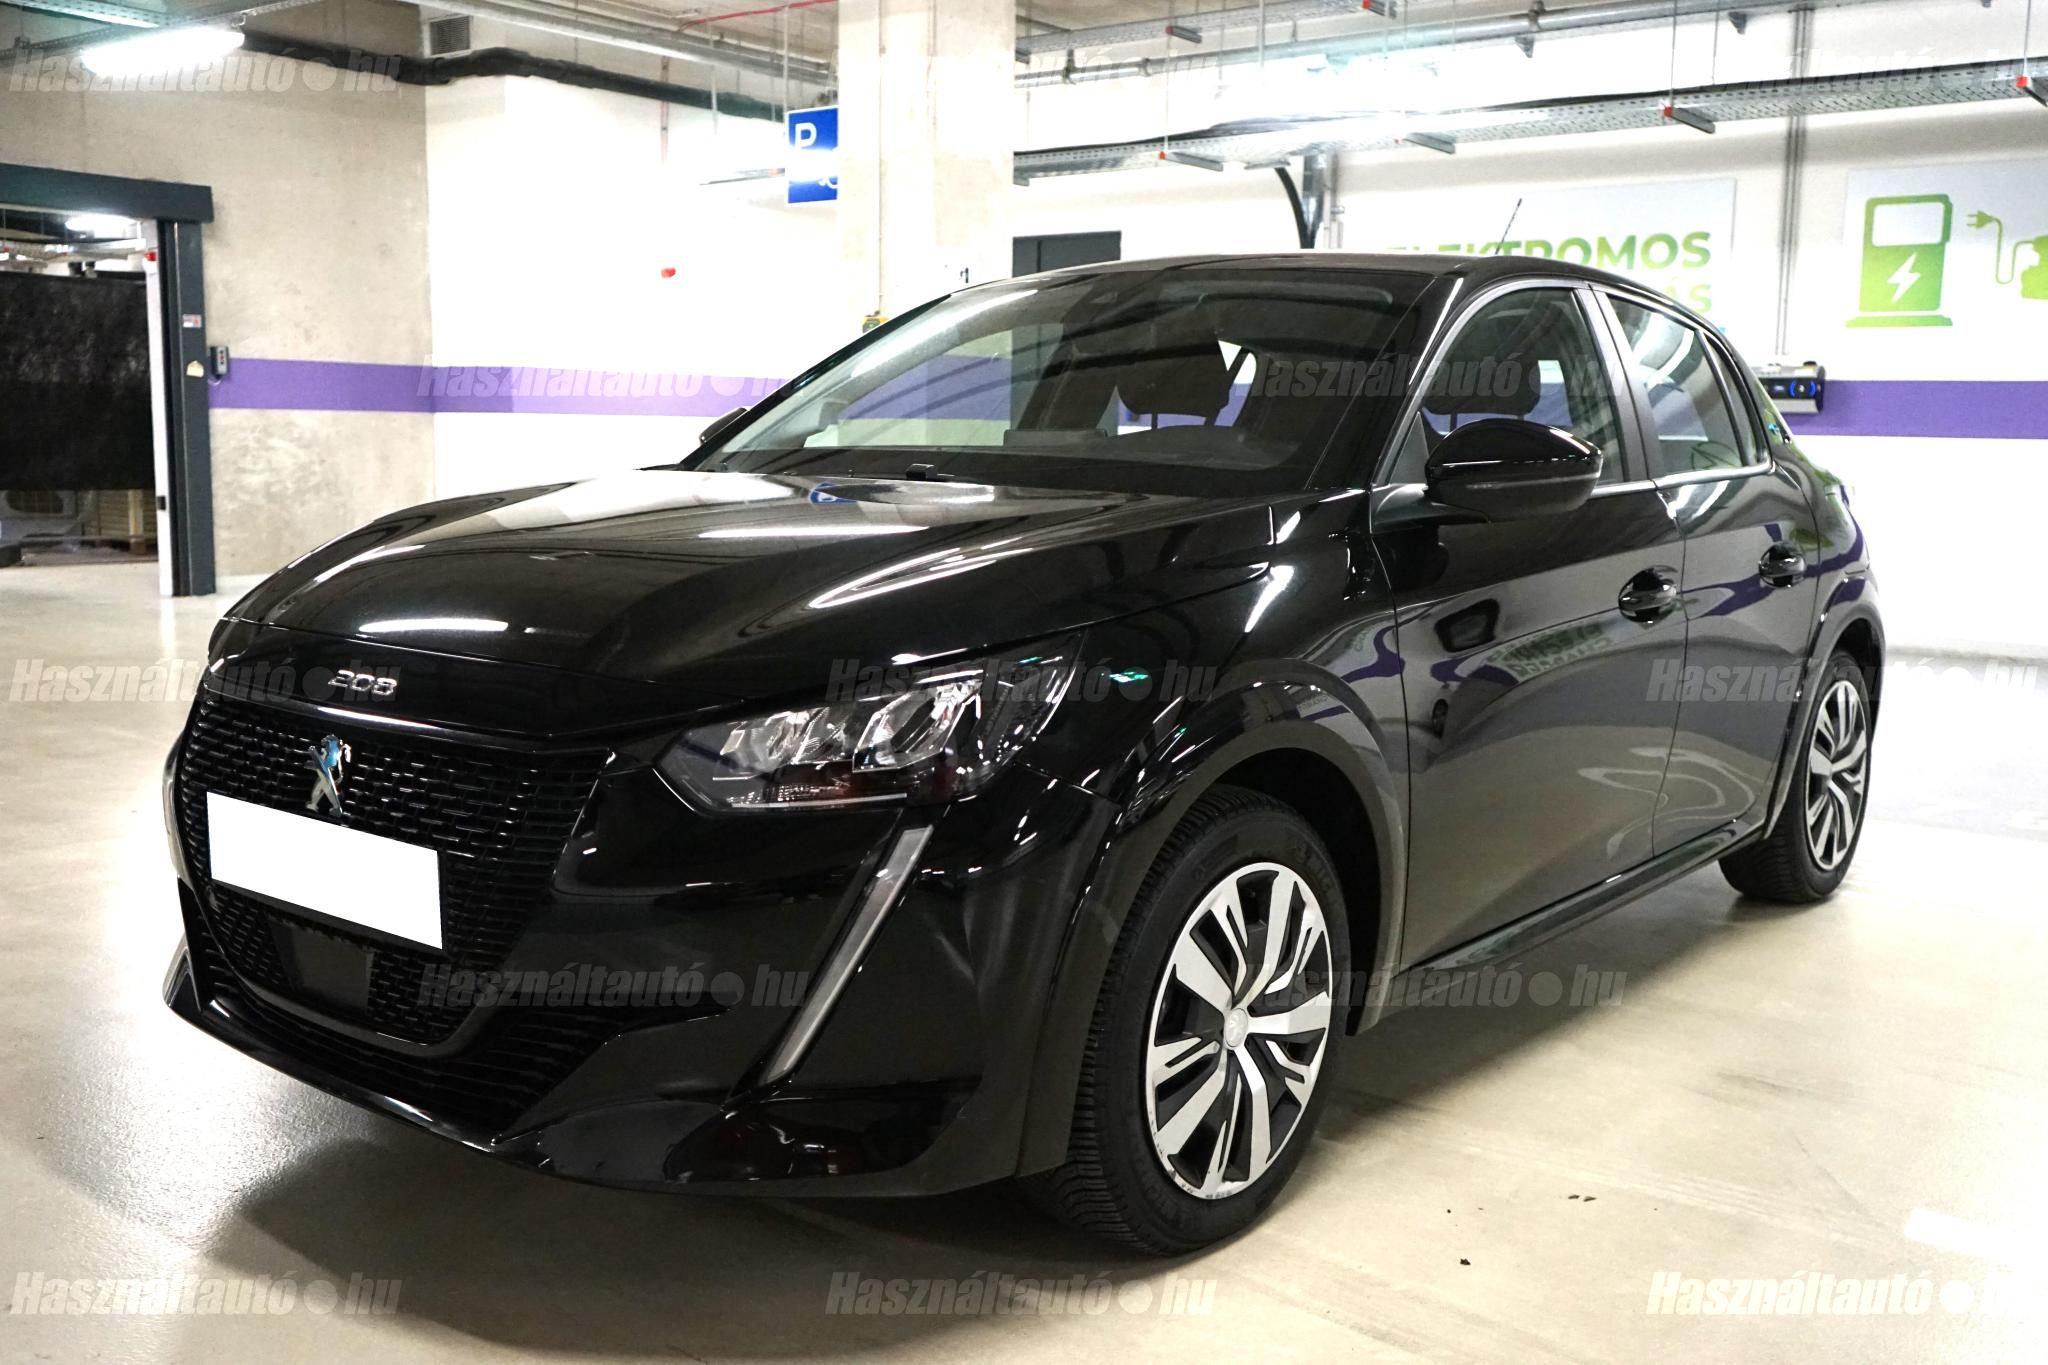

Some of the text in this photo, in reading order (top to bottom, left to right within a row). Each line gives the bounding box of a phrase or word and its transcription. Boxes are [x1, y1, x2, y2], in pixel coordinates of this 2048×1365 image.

[795, 122, 817, 150] P
[1385, 231, 1711, 270] TROMOS
[328, 669, 398, 696] 208
